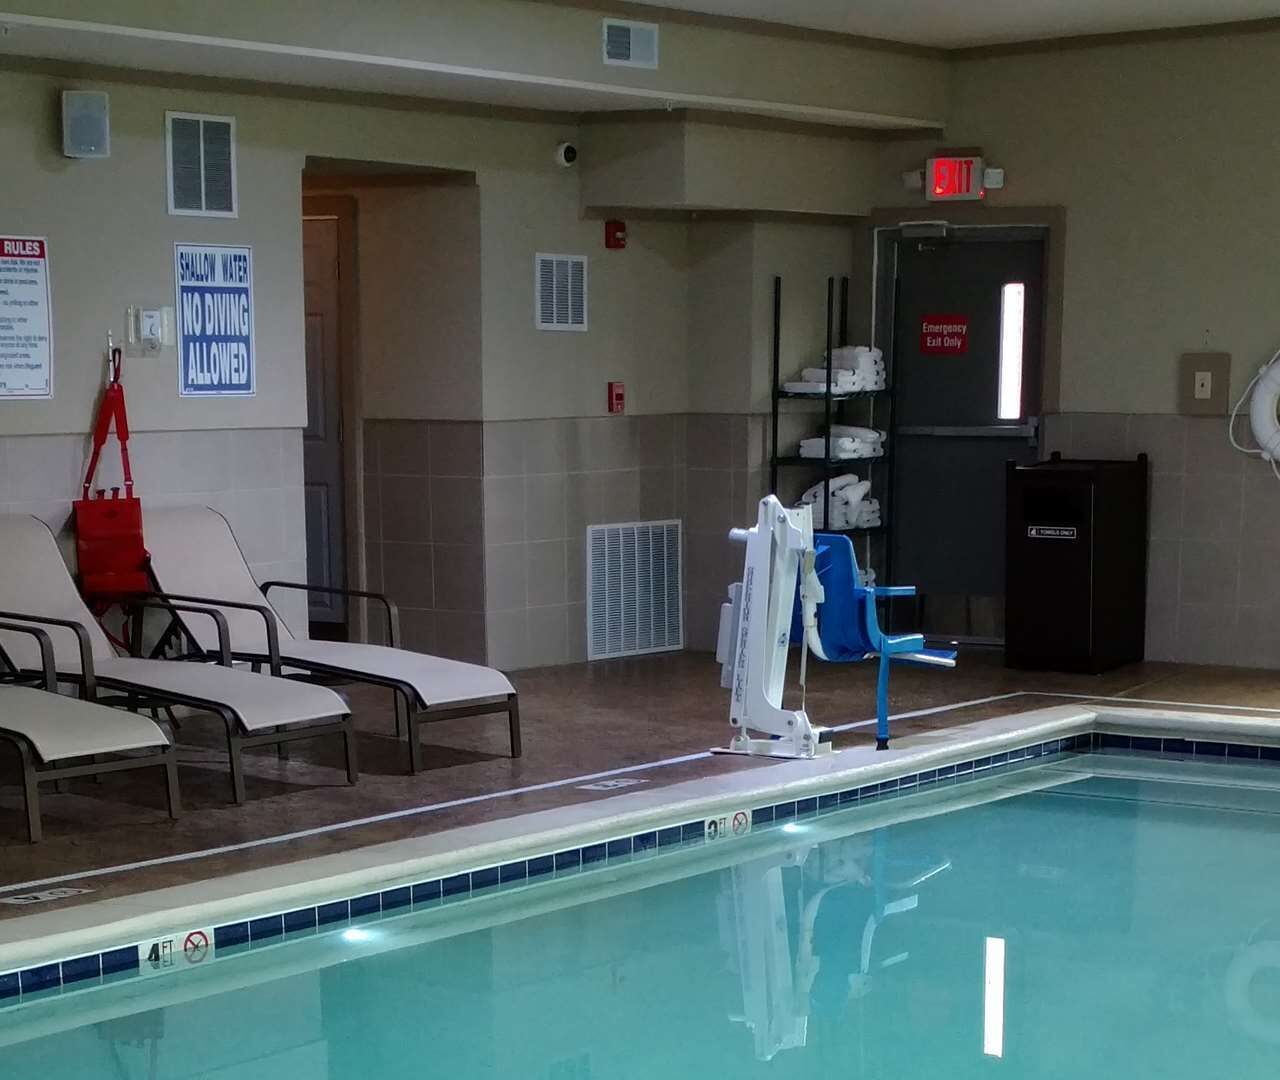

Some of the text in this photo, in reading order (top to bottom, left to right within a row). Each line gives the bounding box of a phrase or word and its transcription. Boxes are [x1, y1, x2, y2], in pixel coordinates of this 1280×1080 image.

[935, 159, 973, 194] EXIT
[4, 241, 41, 256] RULES
[179, 251, 248, 283] SHALLOW WATER
[183, 292, 249, 337] NO DIVING
[922, 322, 967, 335] Emergency
[927, 335, 962, 349] Exit Only
[188, 341, 248, 385] ALLOWED
[147, 942, 160, 962] 4
